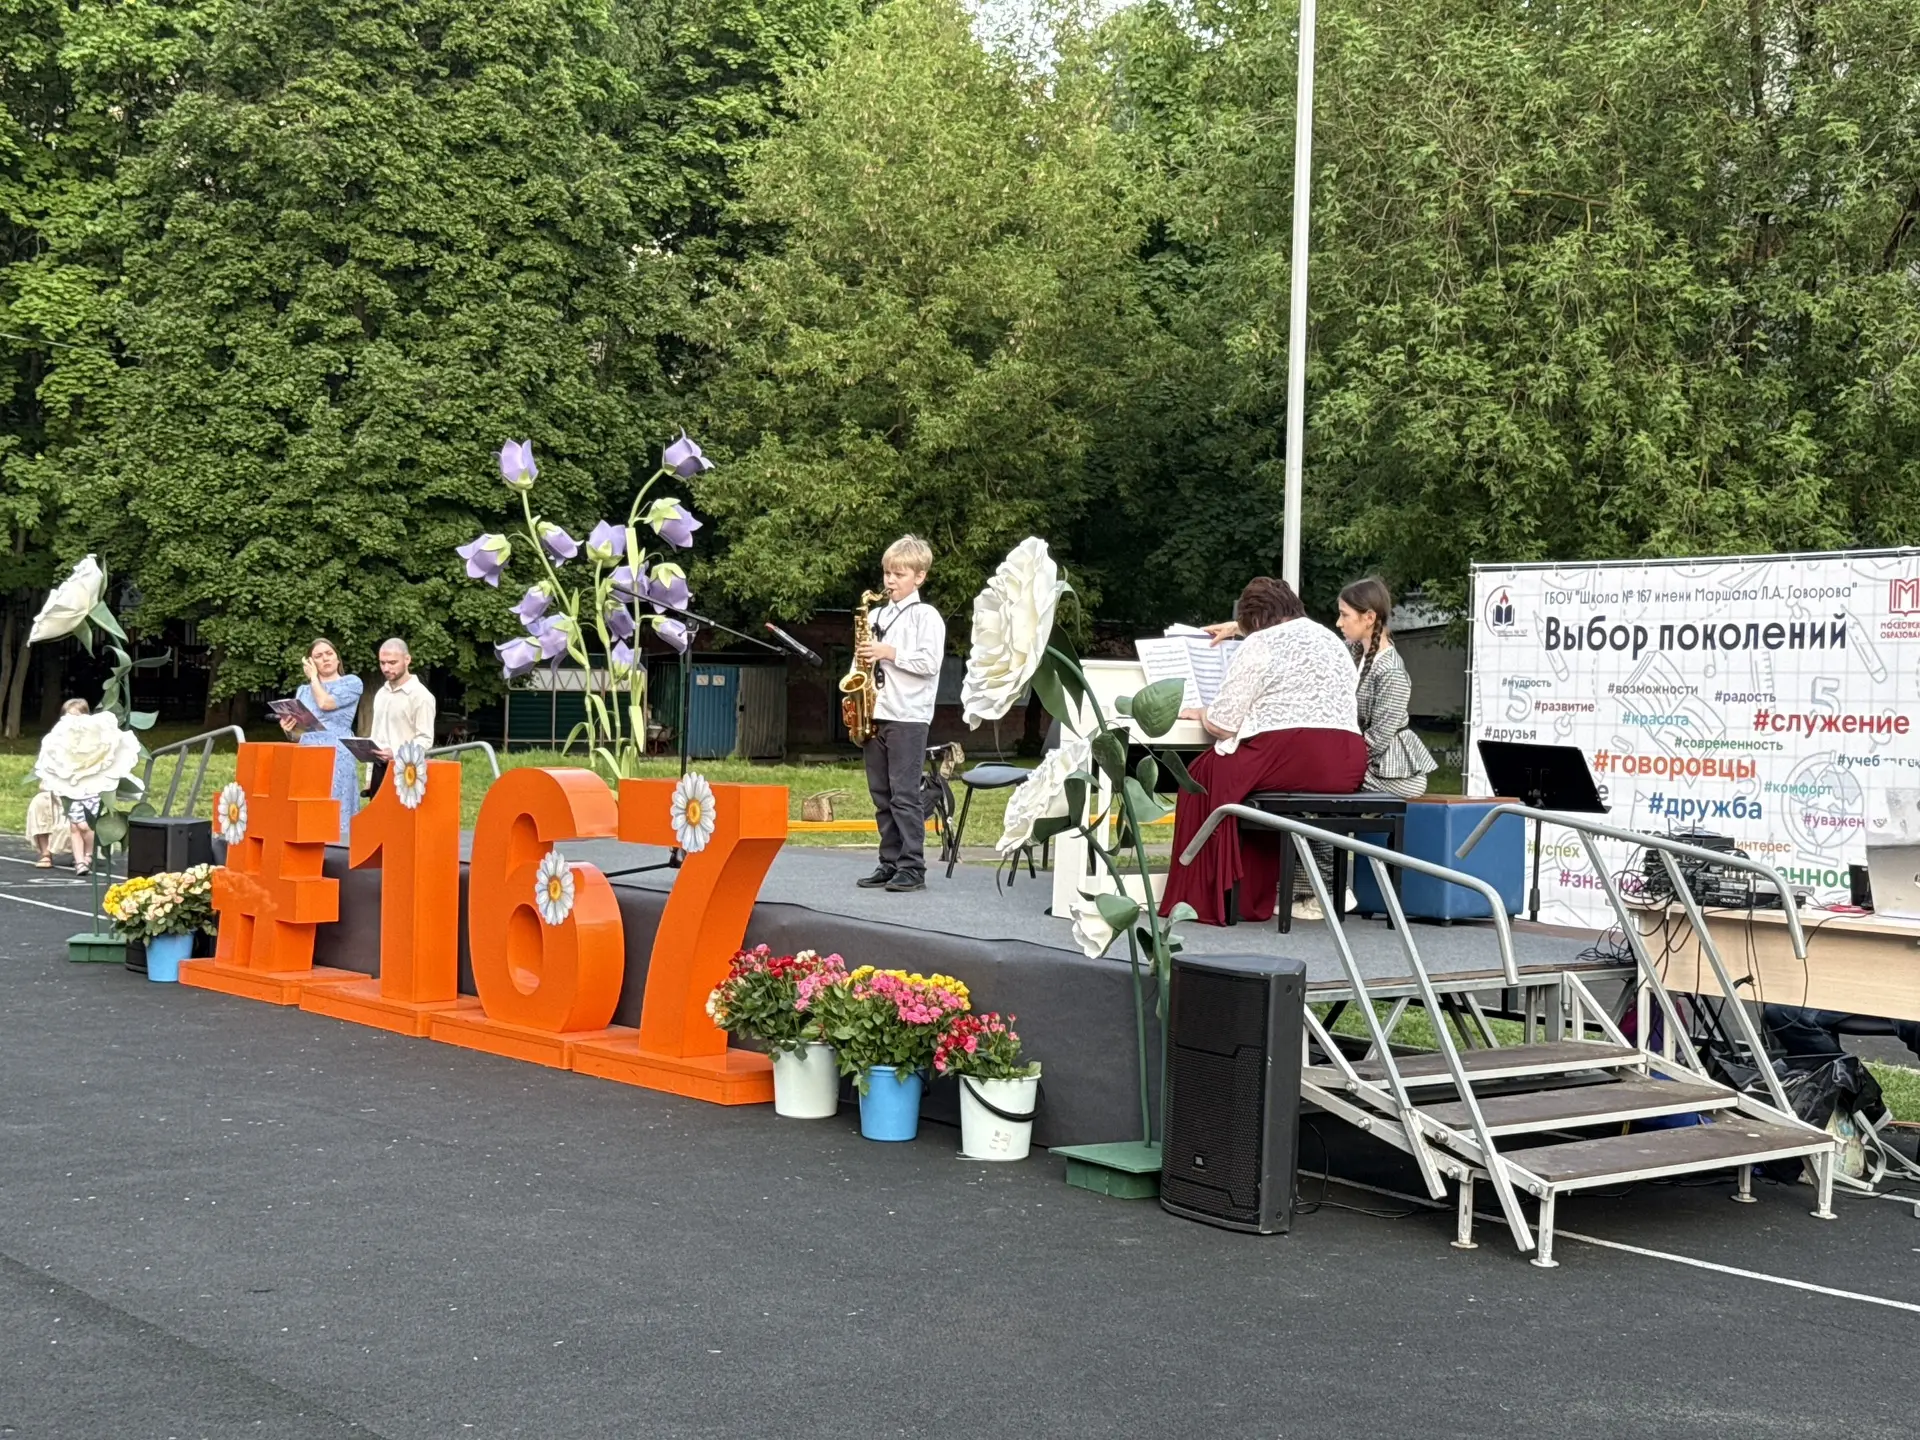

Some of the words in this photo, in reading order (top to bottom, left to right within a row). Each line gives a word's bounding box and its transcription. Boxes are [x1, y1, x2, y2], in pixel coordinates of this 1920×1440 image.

[1544, 591, 1572, 605] ГБОУ
[1575, 590, 1619, 605] "Школа
[1637, 589, 1652, 604] 167
[1655, 589, 1691, 603] имени
[1695, 587, 1758, 604] Маршала
[1761, 585, 1784, 600] Л.А.
[1787, 582, 1857, 602] Говорова"
[1545, 615, 1648, 660] Выбор
[1659, 612, 1847, 650] поколений
[1501, 676, 1552, 689] #мудрость
[1607, 682, 1699, 696] #возможности
[1714, 690, 1777, 705] #радость
[1534, 700, 1595, 714] #развитие
[1622, 712, 1689, 727] #красота
[1753, 708, 1910, 738] #служение
[1484, 725, 1537, 742] #друзья
[1674, 736, 1783, 751] #современность
[1593, 748, 1756, 781] #говоровцы
[1763, 780, 1833, 796] #комфорт
[1648, 792, 1763, 821] #дружба
[1735, 840, 1792, 854] интерес
